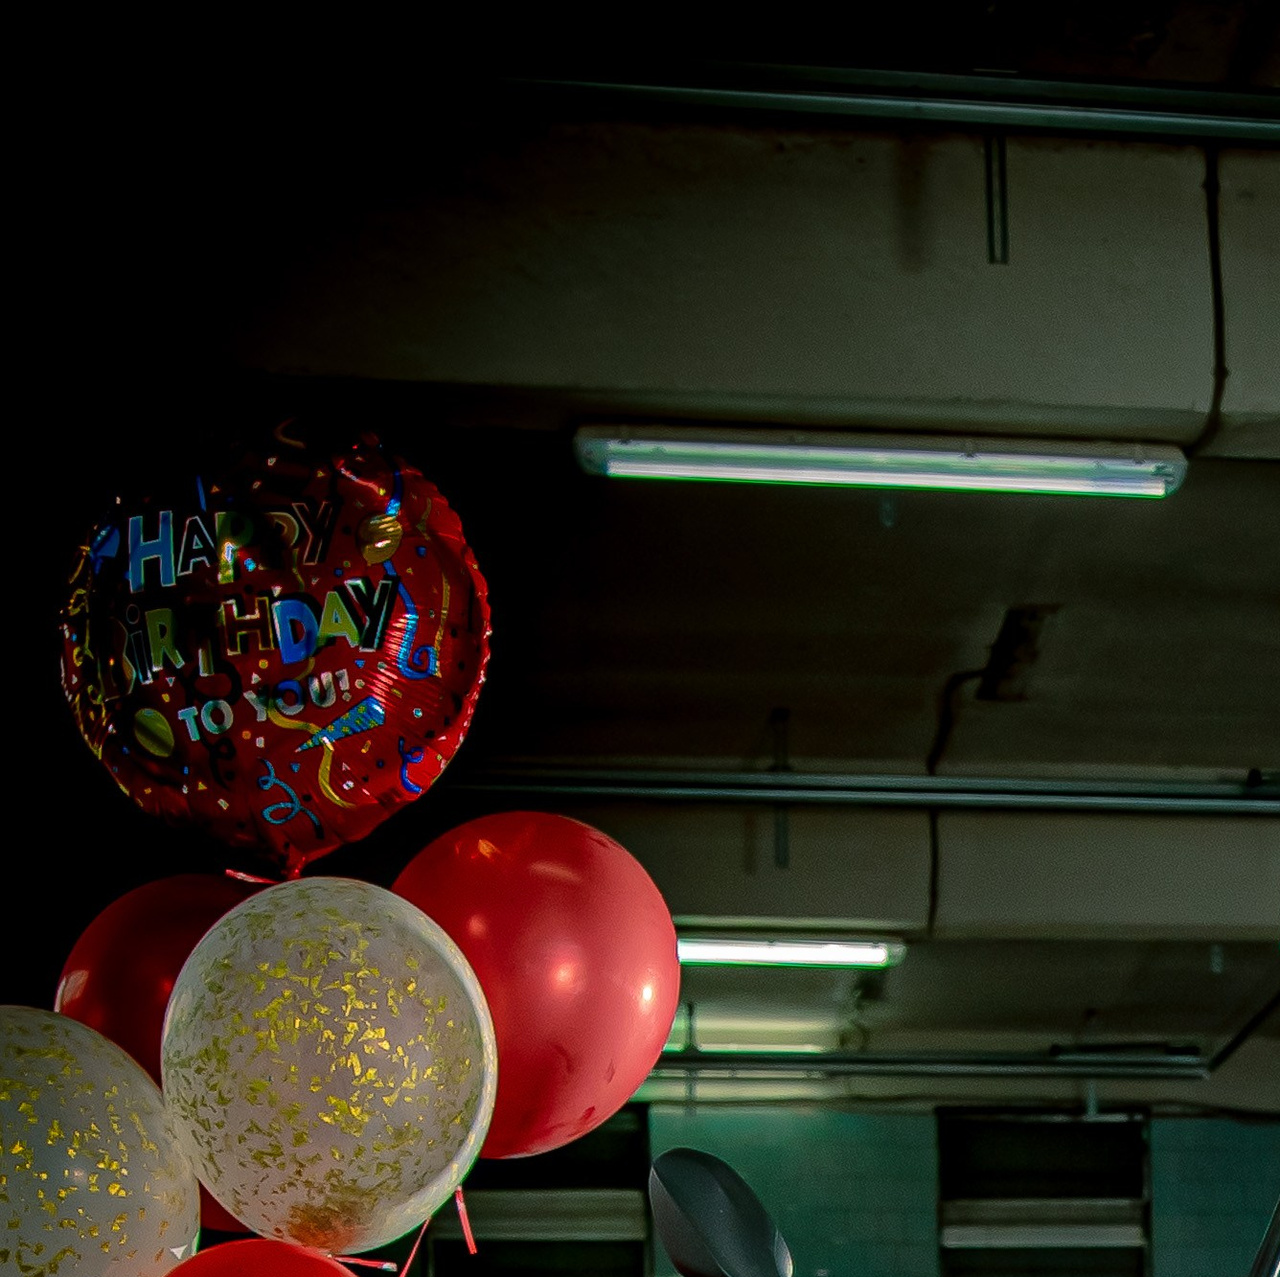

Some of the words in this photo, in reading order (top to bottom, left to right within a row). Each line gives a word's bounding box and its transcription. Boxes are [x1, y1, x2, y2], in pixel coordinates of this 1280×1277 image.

[128, 501, 335, 593] HAPPY
[177, 699, 234, 742] TO
[243, 668, 352, 723] YOU!
